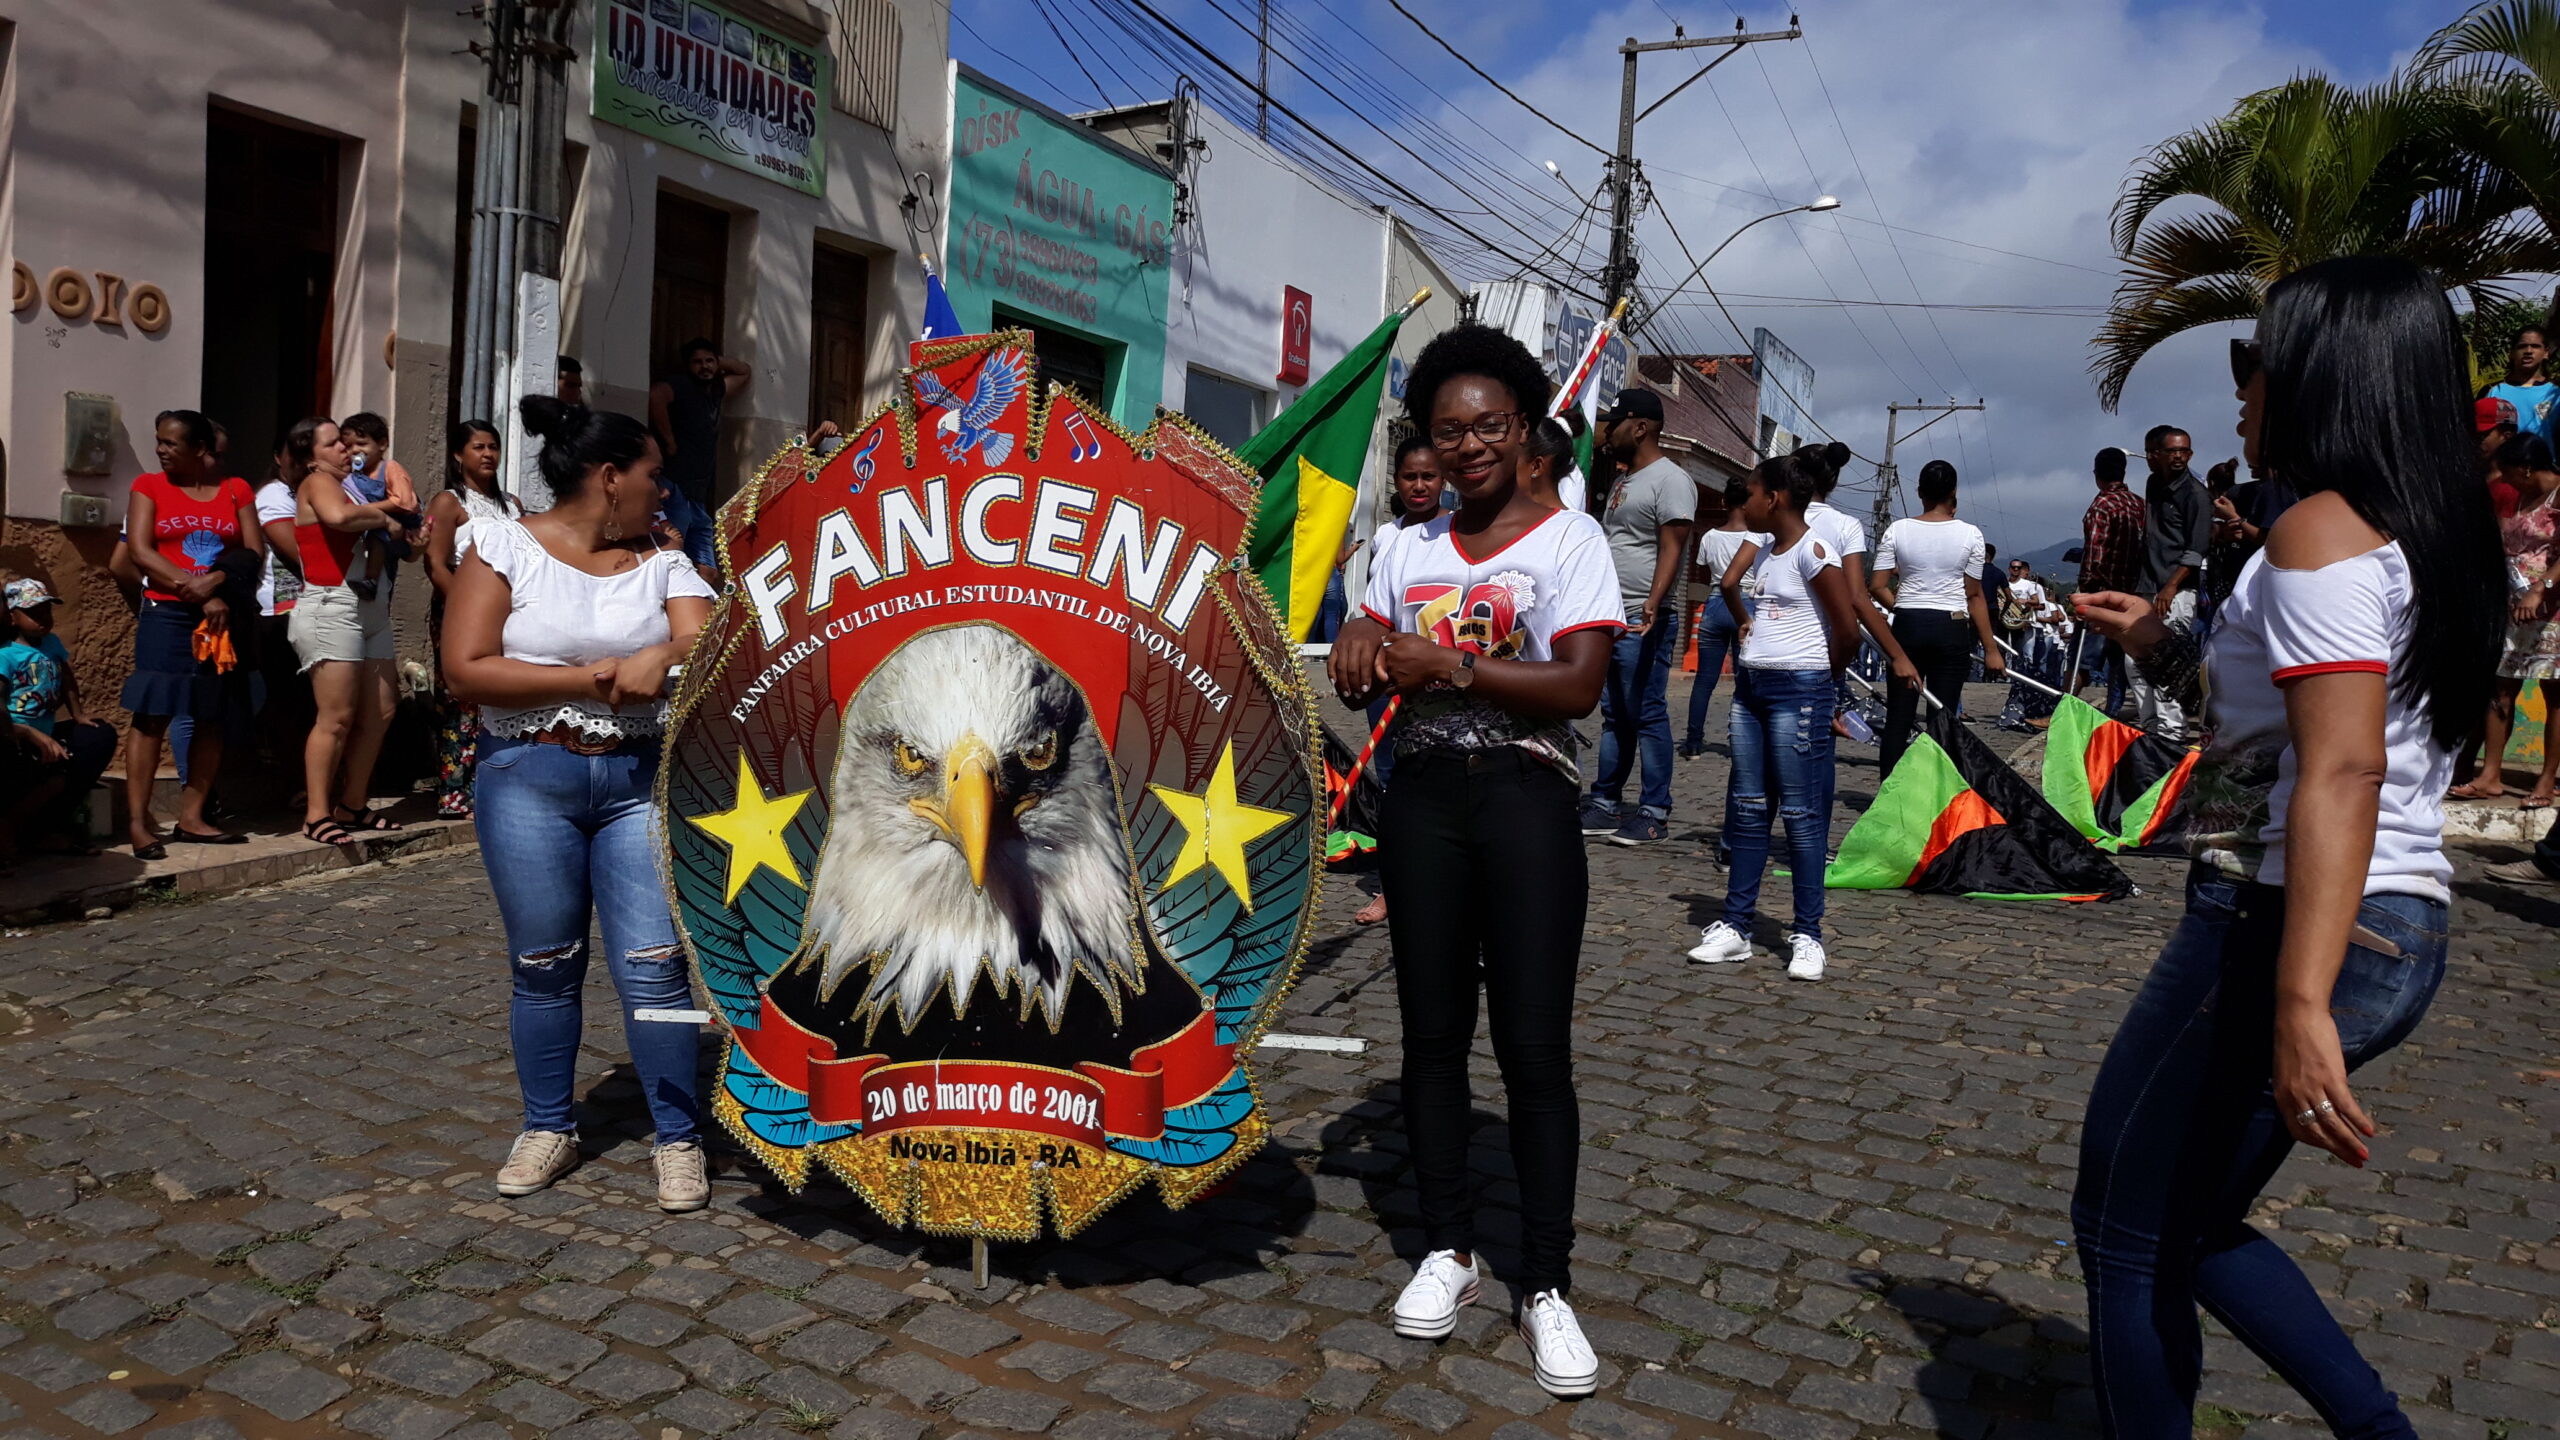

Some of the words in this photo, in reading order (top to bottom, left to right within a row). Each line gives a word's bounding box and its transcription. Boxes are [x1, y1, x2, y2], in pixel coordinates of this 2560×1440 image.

[613, 49, 720, 120] Variedades
[726, 107, 754, 137] em
[760, 109, 812, 158] Geral
[655, 26, 816, 138] UTILIDADES
[960, 211, 1016, 295] (73)
[1013, 148, 1097, 240] ÁGUA
[1115, 204, 1166, 266] GÁS
[158, 515, 235, 535] SEREIA
[742, 473, 1222, 649] FANCENI
[731, 634, 825, 724] FANFARRA
[825, 590, 941, 640] CULTURAL
[945, 585, 1091, 619] ESTUDANTIL
[1095, 605, 1131, 633] DE
[1130, 622, 1187, 671] NOVA
[1186, 664, 1233, 714] IBIÁ
[1458, 622, 1486, 637] ANOS
[868, 1086, 896, 1122] 20
[903, 1082, 929, 1113] de
[936, 1082, 1002, 1115] março
[1009, 1081, 1036, 1115] de
[1042, 1086, 1098, 1130] 2001
[890, 1135, 957, 1163] Nova
[965, 1140, 1016, 1166] Ibiá
[1039, 1143, 1081, 1168] BA
